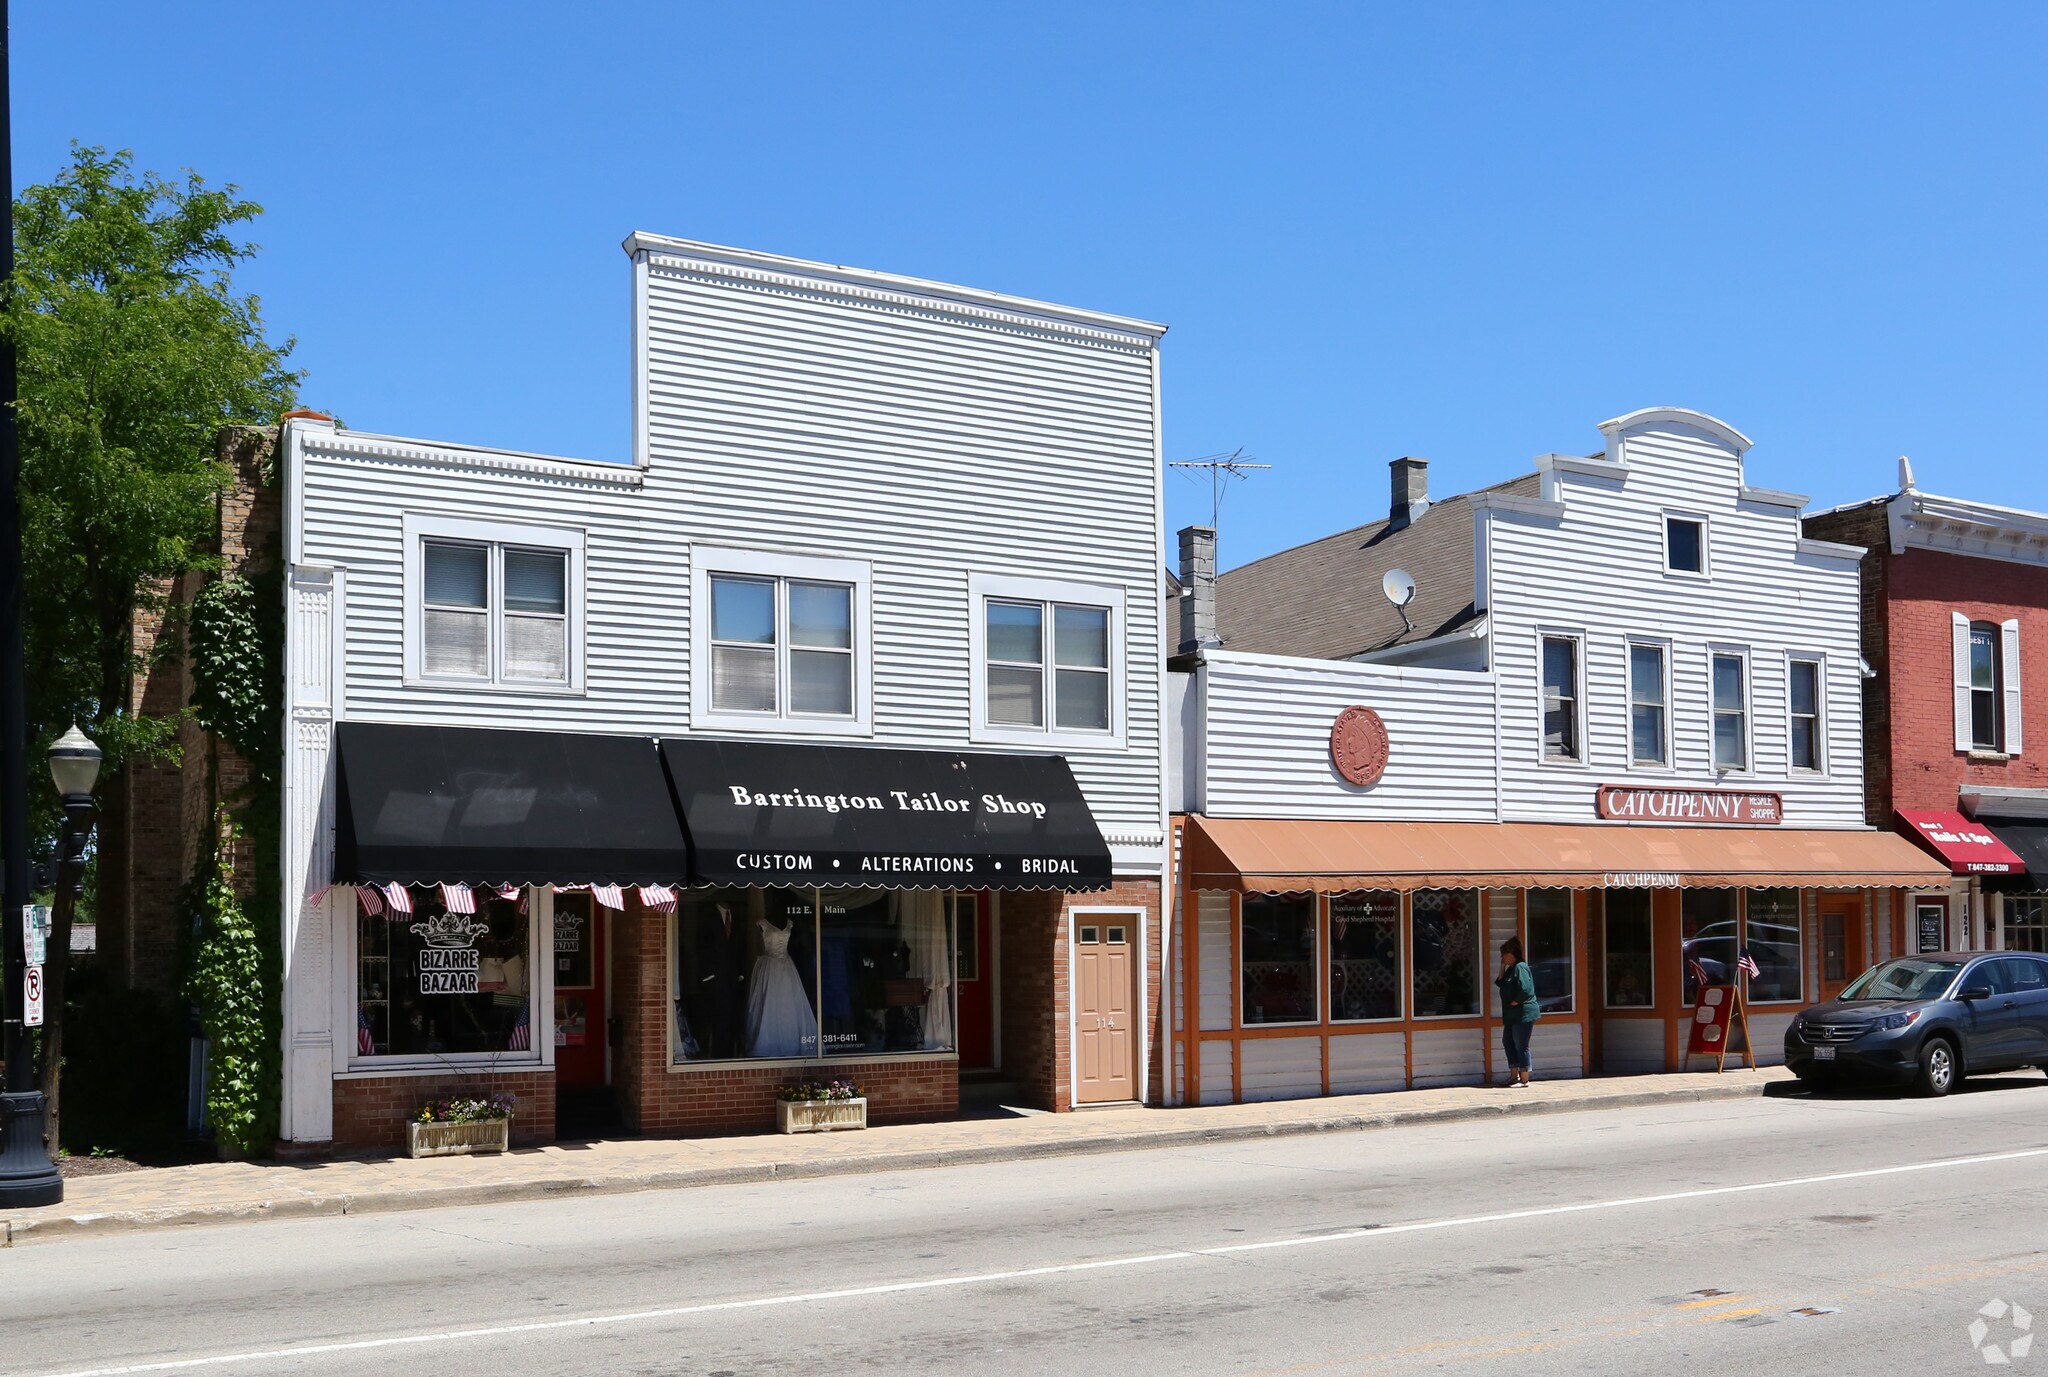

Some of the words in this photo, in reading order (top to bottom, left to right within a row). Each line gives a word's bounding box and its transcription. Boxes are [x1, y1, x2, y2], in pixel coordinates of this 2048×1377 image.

[728, 785, 885, 813] Barrington
[889, 790, 971, 812] Tailor
[981, 793, 1047, 819] Shop
[1607, 789, 1746, 819] CATCHPENNY
[1749, 794, 1773, 807] RESALE
[1750, 808, 1776, 820] SHOPPE
[1929, 831, 1961, 843] Nails
[1958, 832, 1972, 843] &
[1968, 833, 1994, 845] Spa
[736, 853, 813, 870] CUSTOM
[861, 855, 974, 872] ALTERATIONS
[1022, 858, 1079, 874] BRIDAL
[1604, 872, 1681, 887] CATCHPENNY
[786, 906, 802, 914] 112
[803, 906, 813, 914] E.
[824, 905, 846, 914] Main
[1351, 915, 1375, 924] Shepherd
[1375, 915, 1396, 924] Hospital
[554, 930, 580, 941] IZARRE
[420, 949, 480, 970] BIZARRE
[420, 972, 479, 994] BAZAAR
[1096, 1016, 1115, 1029] 114
[801, 1035, 816, 1044] 847
[822, 1033, 857, 1043] 381-6411
